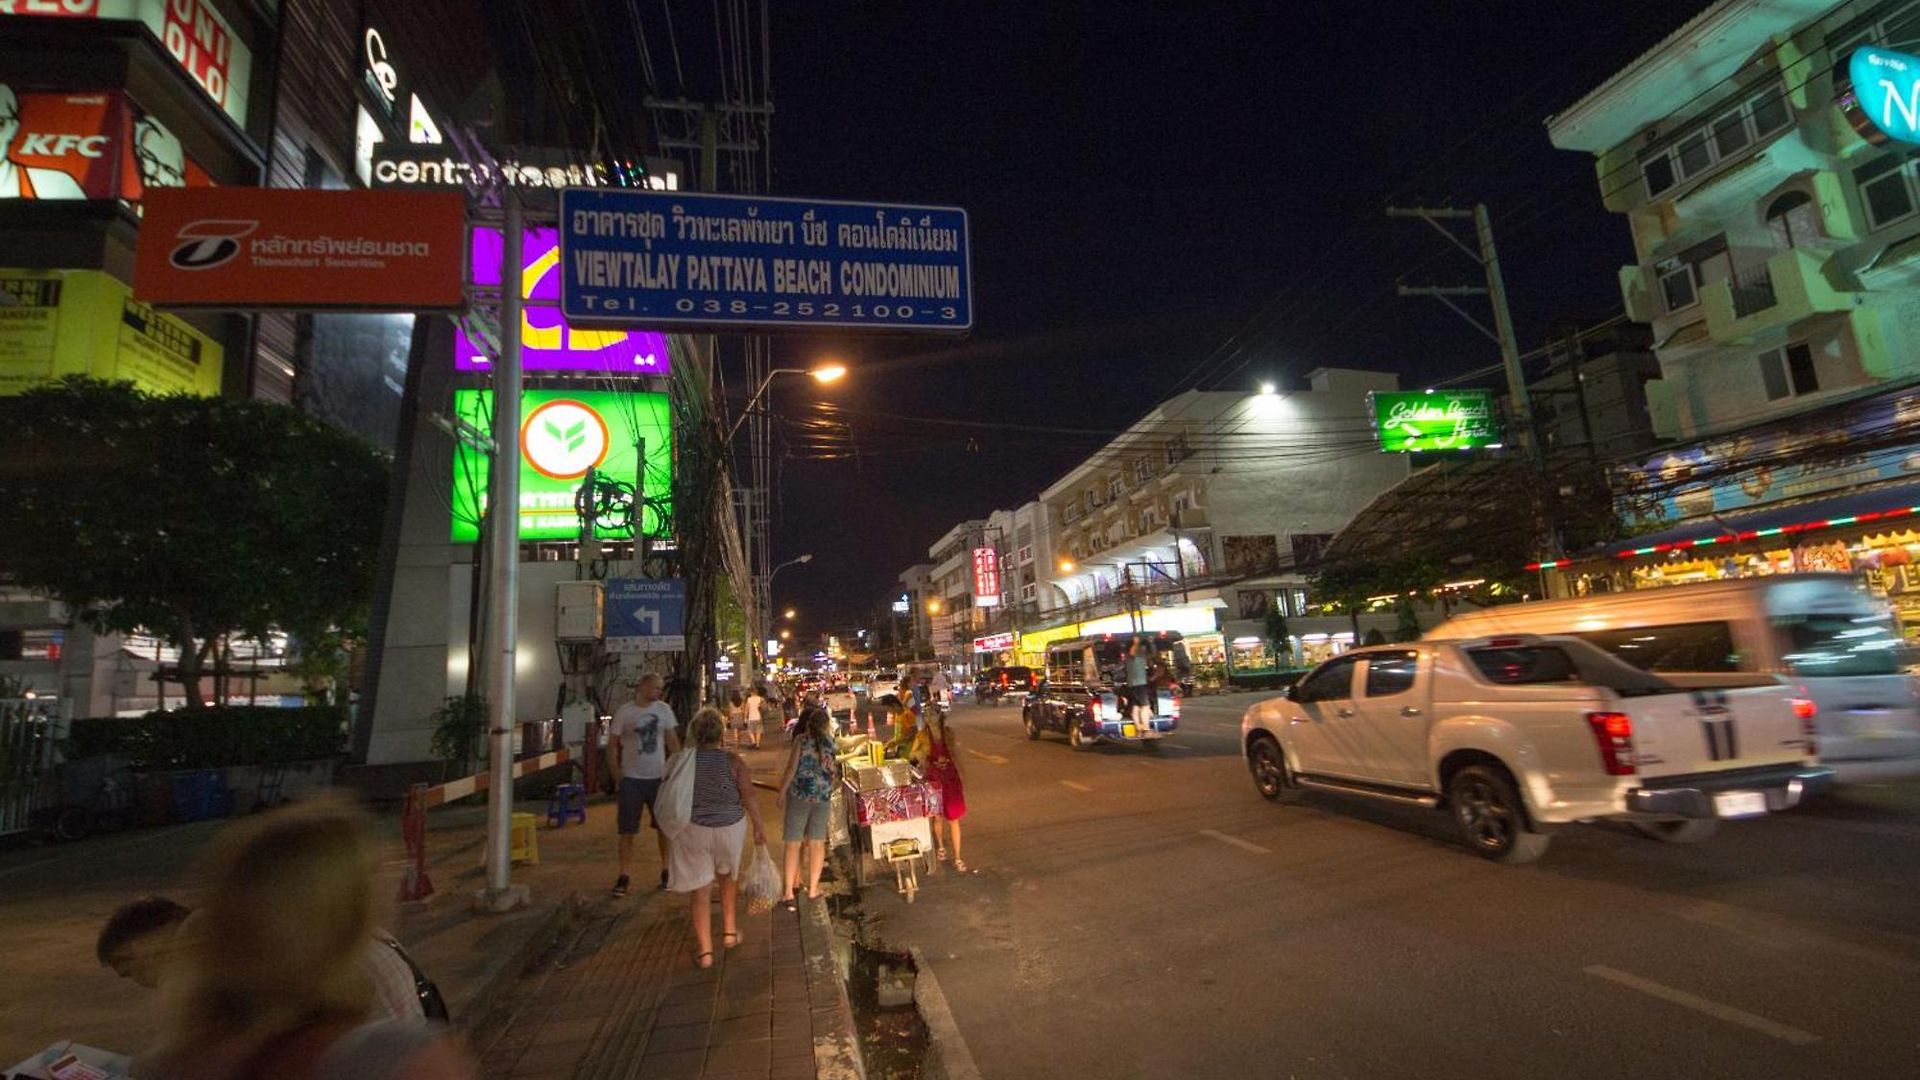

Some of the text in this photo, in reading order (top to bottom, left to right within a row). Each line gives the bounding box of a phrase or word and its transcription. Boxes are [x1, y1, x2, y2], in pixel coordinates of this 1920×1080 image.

[19, 133, 108, 158] KFC
[573, 209, 665, 250] อาคารชุด
[672, 205, 794, 245] วิวทะเลพัทยา
[838, 211, 958, 251] คอนโดมิเนียม
[575, 250, 960, 298] VIEWTALAY PATTAYA BEACH CONDOMINIUM
[581, 295, 957, 319] Tel. 038-252100-3
[1384, 401, 1444, 428] Golden
